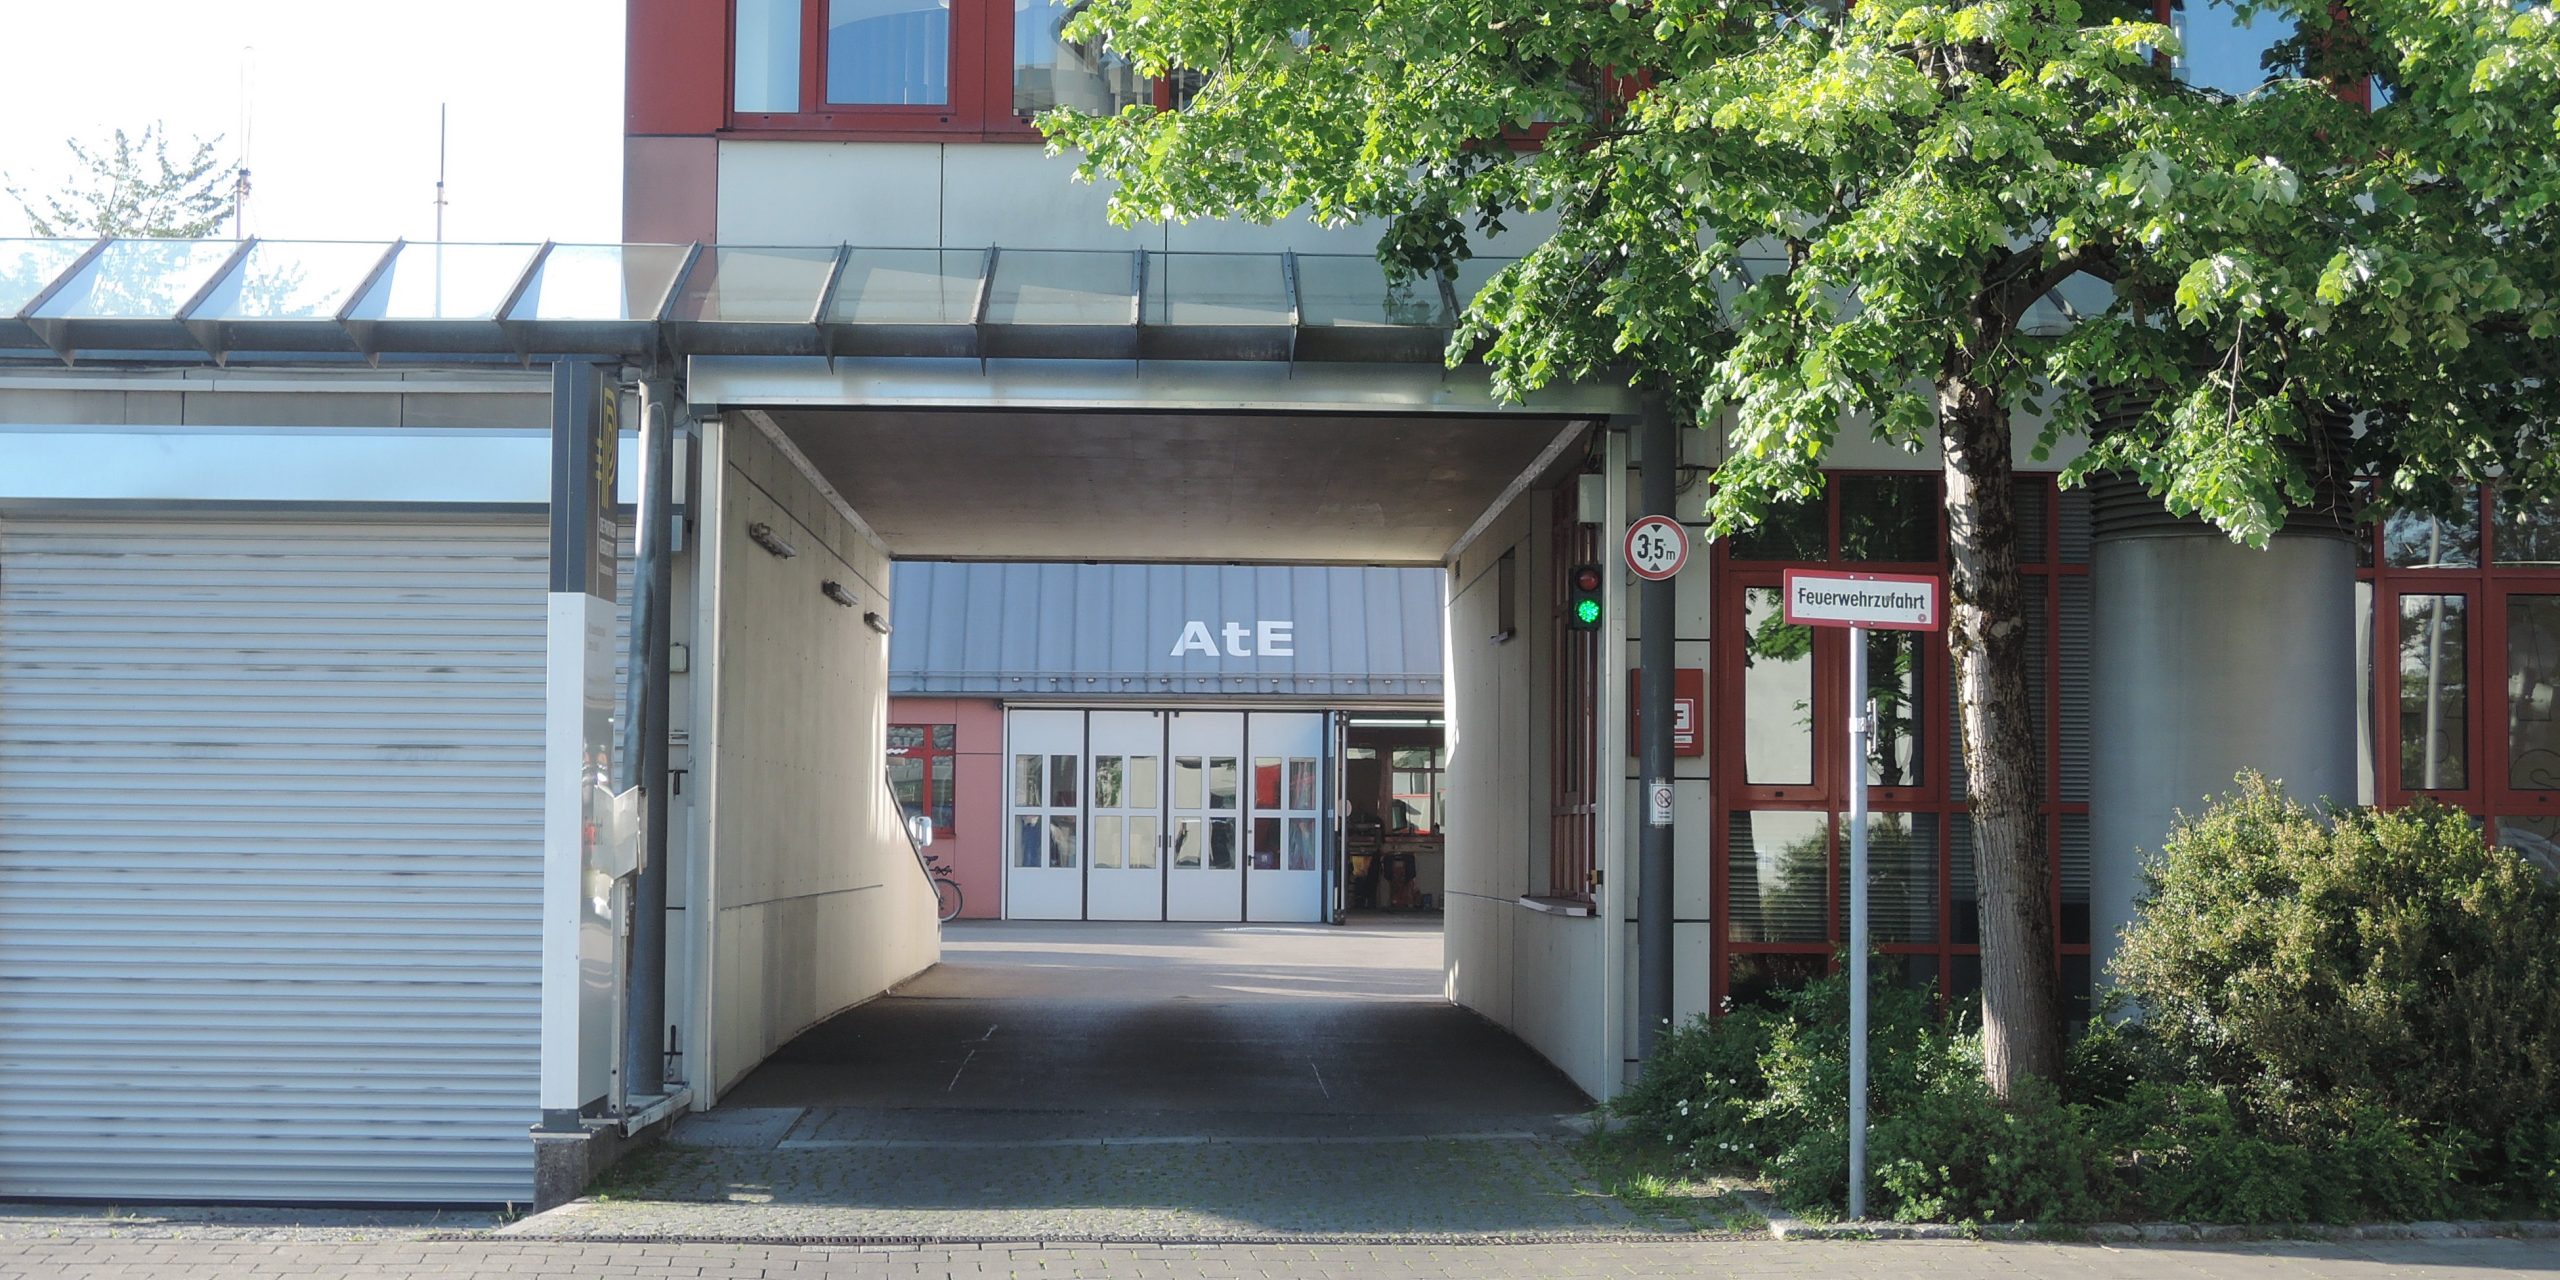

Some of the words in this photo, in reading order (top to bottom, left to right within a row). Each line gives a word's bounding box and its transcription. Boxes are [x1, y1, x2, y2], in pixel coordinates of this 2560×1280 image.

[1637, 534, 1664, 562] 3,5
[1798, 587, 1925, 610] Feuerwehrzufahrt
[1170, 621, 1294, 656] AtE
